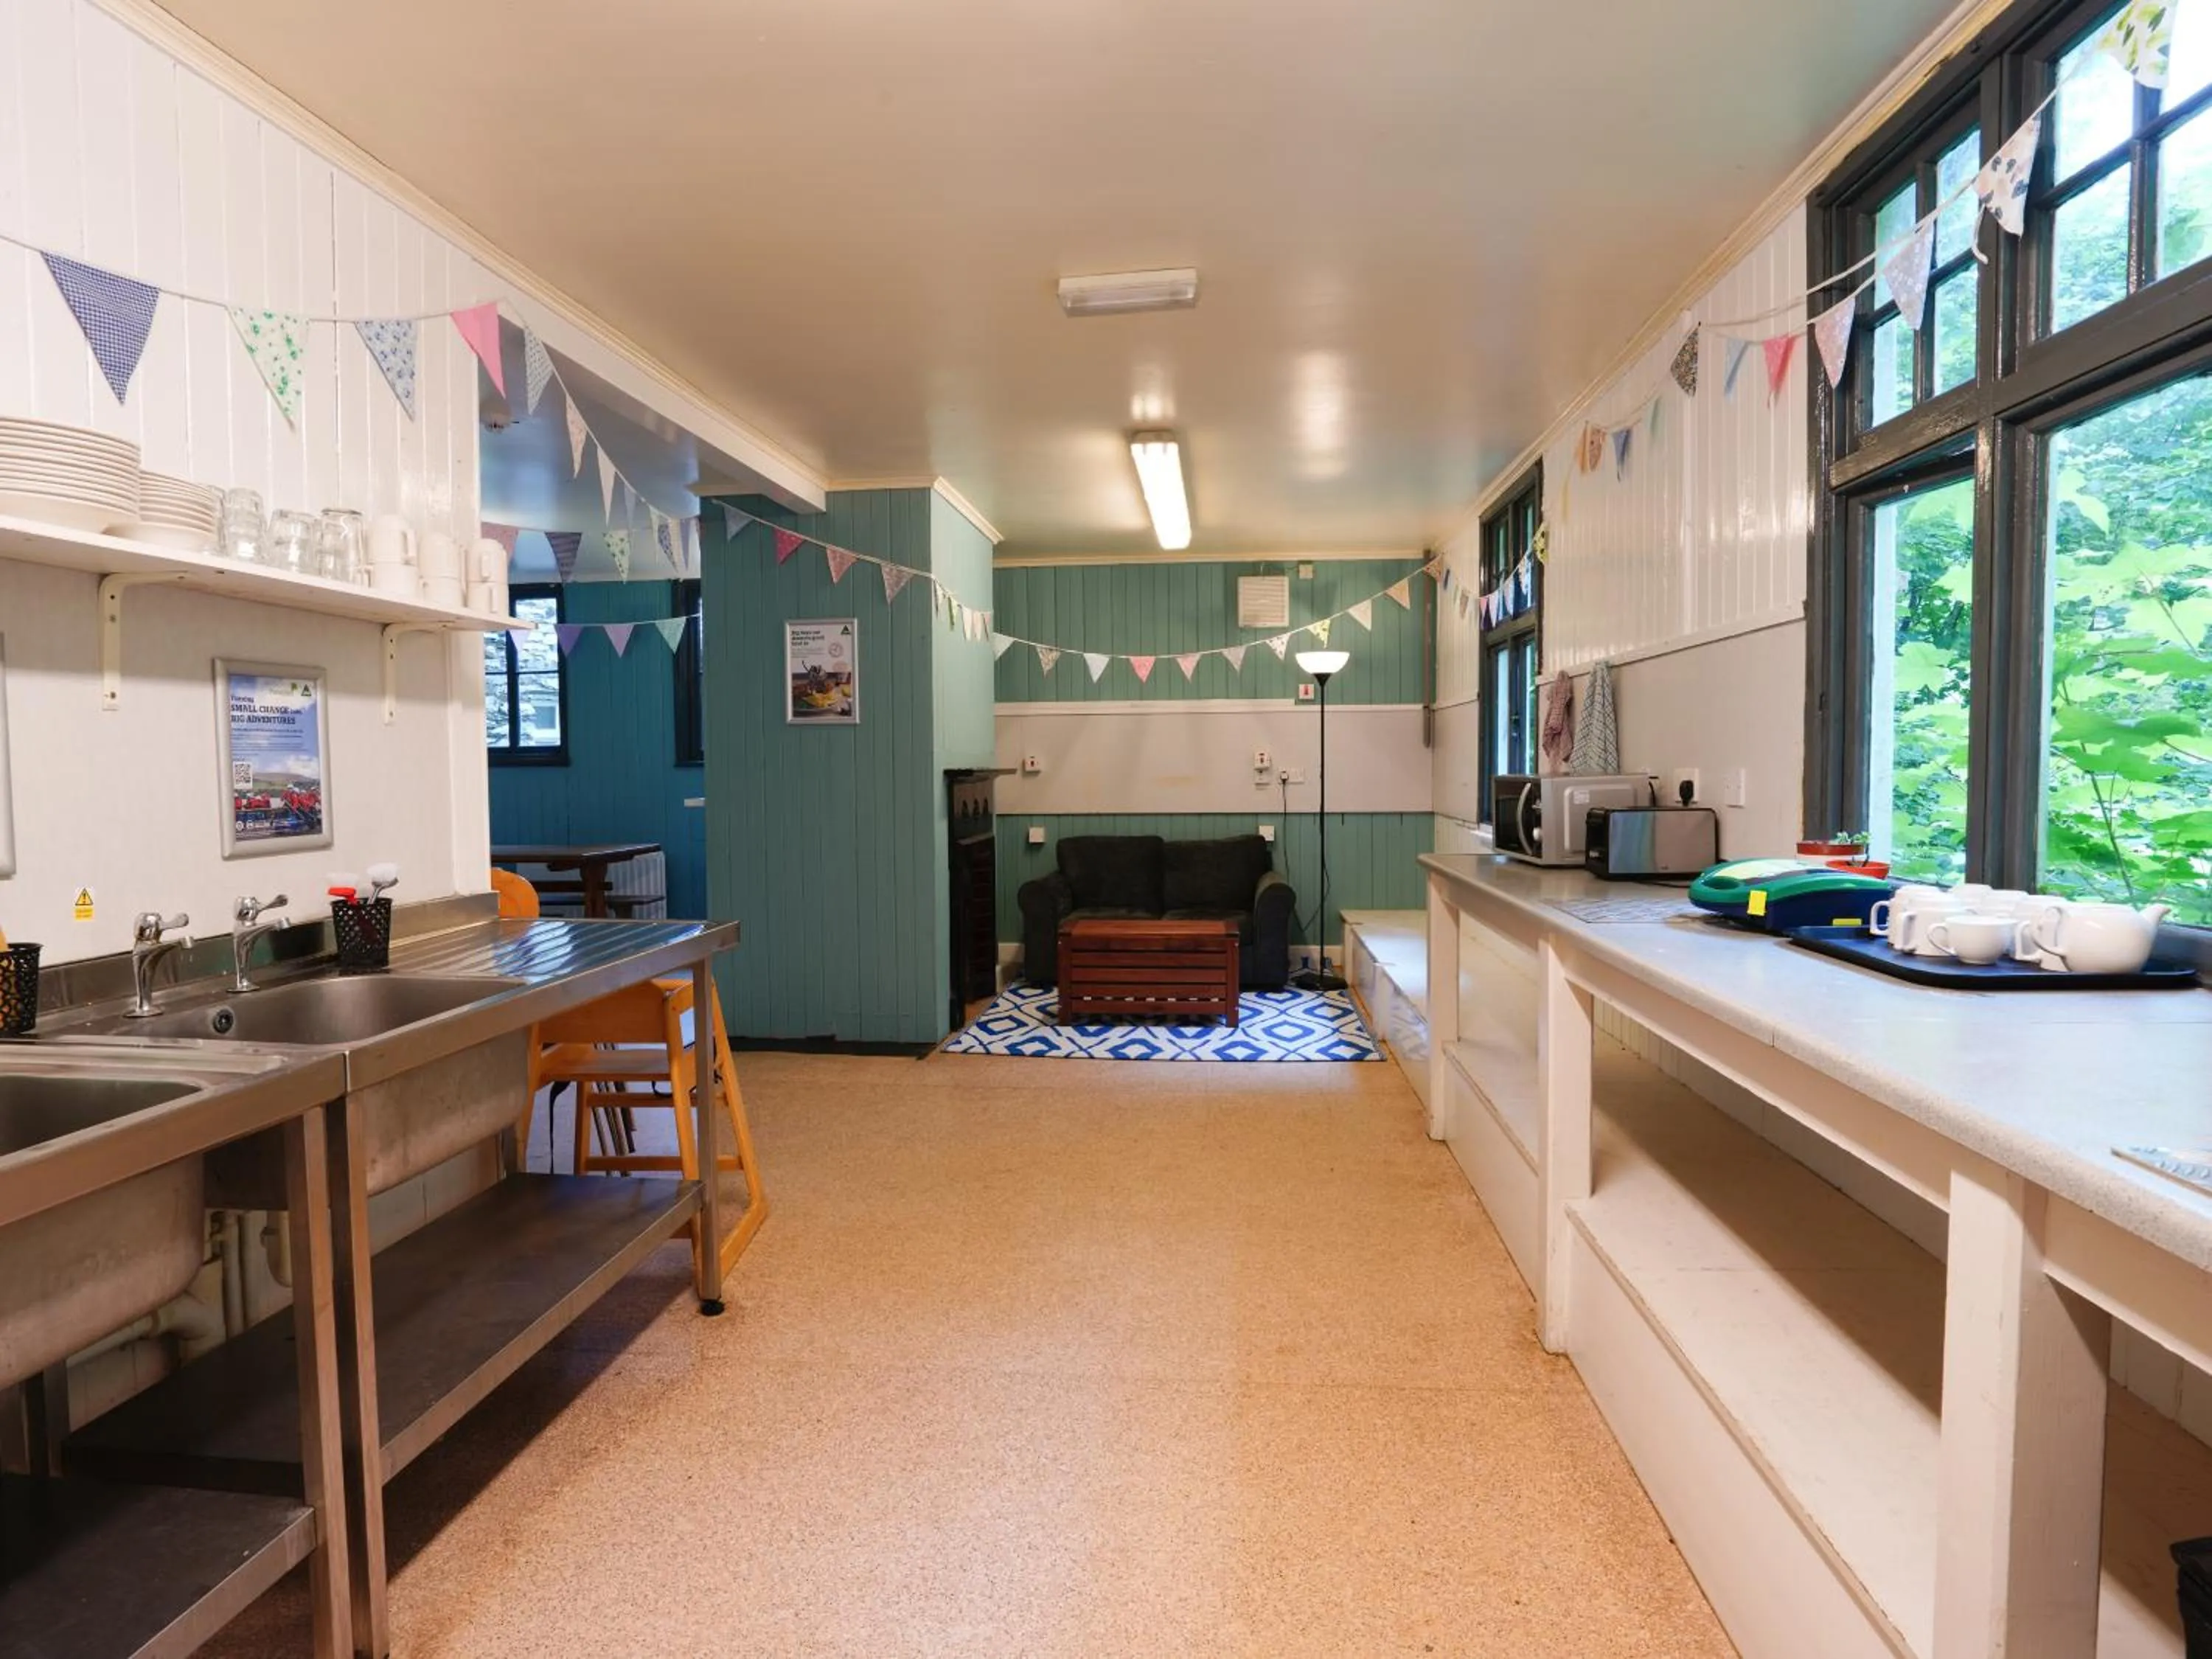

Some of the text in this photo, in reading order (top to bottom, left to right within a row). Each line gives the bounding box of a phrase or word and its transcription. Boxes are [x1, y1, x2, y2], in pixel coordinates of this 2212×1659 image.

[232, 704, 257, 712] SMALL
[259, 706, 289, 714] CHANGE
[246, 715, 296, 724] ADVENTURES
